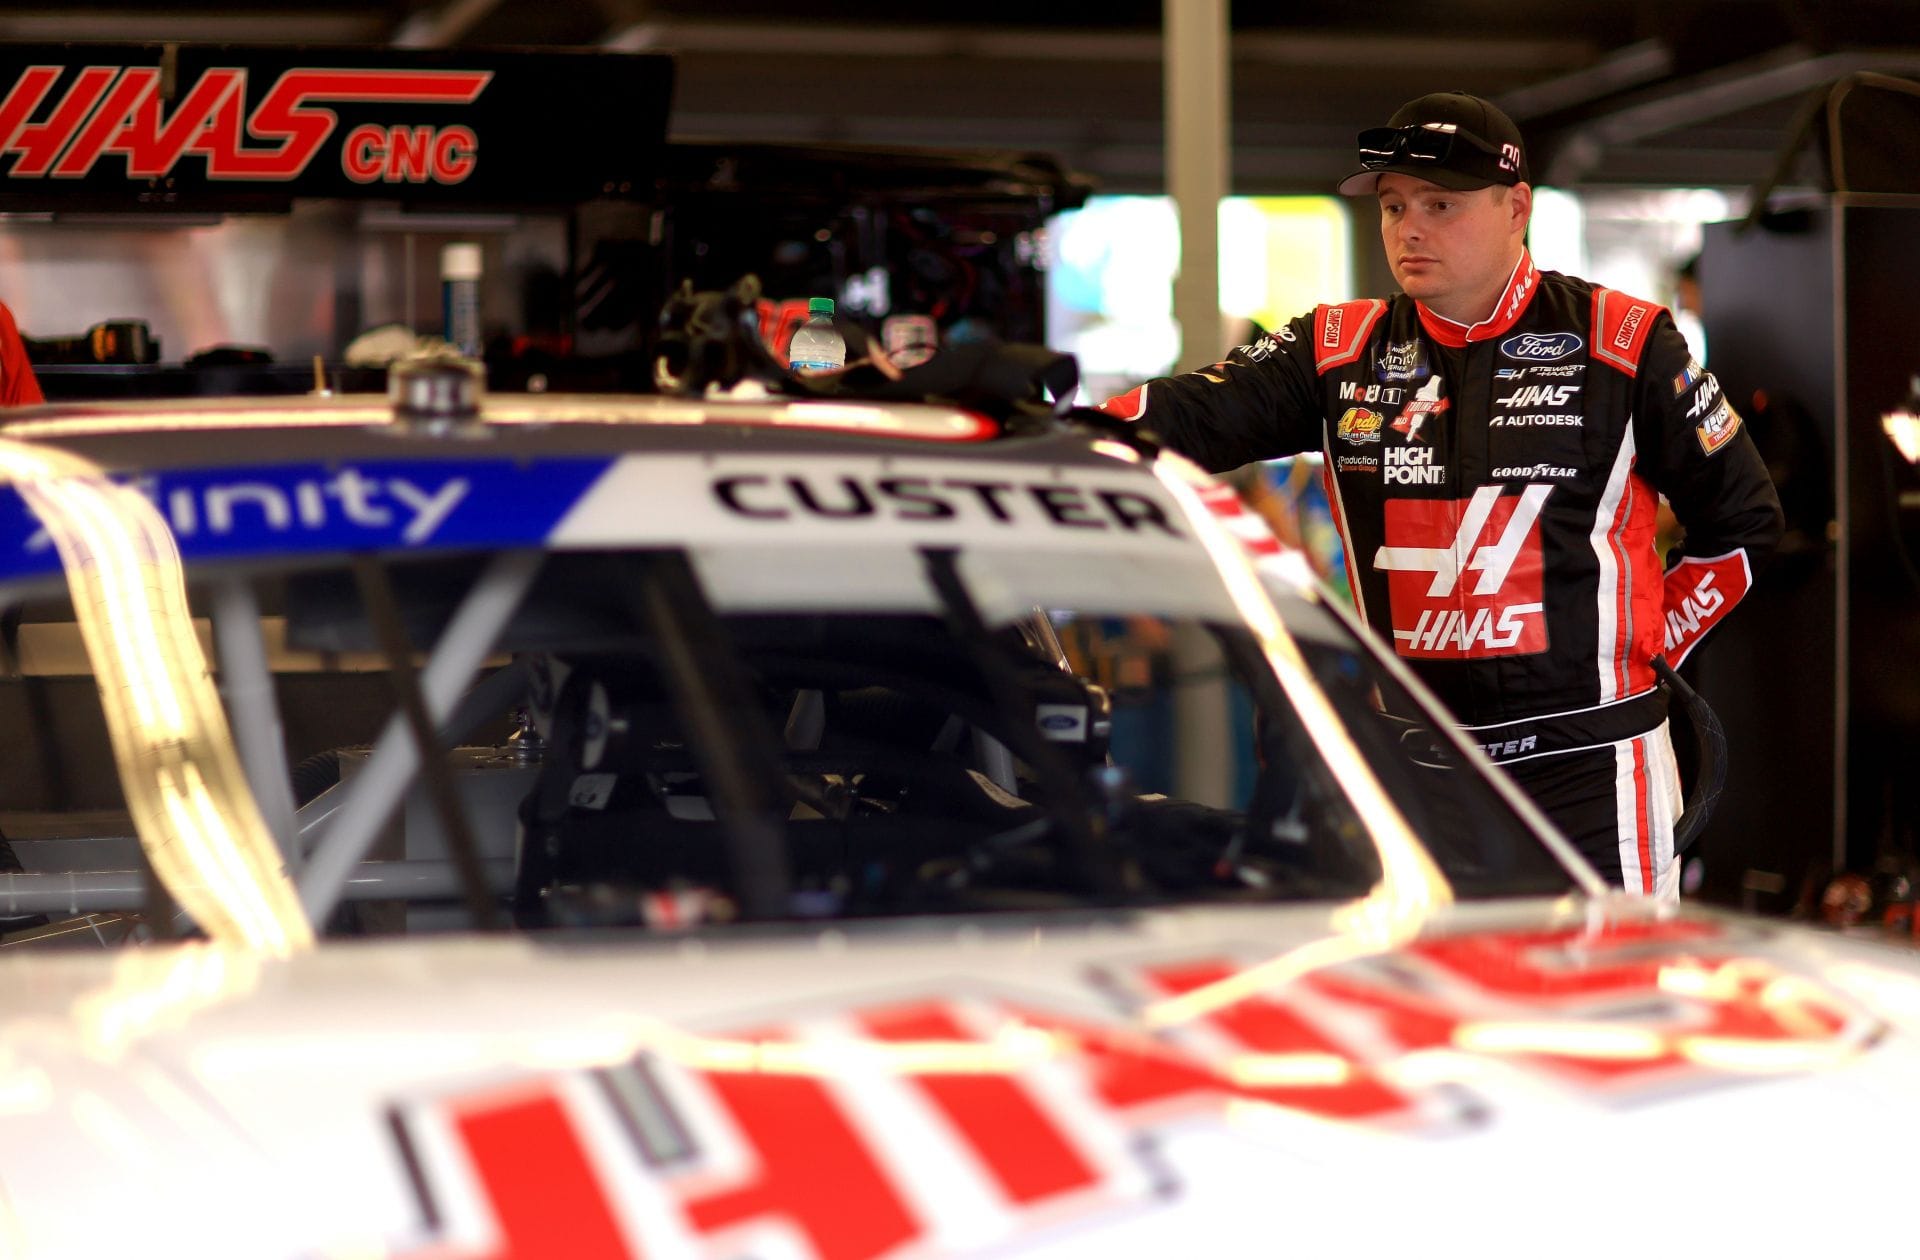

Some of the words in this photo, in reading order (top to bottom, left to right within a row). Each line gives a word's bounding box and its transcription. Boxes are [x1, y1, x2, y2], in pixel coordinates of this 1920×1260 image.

[0, 65, 495, 180] HAAS
[342, 124, 479, 184] CNC
[1325, 309, 1341, 344] SIMPSON
[1616, 307, 1644, 347] SIMPSON
[1516, 336, 1566, 356] Ford
[1529, 364, 1587, 373] STEWART
[1495, 385, 1580, 408] HAAS
[1685, 373, 1720, 419] HAA
[1506, 414, 1584, 427] AUTODESK
[1340, 456, 1378, 465] Production
[1384, 447, 1433, 466] HIGH
[1384, 465, 1442, 485] POINT
[1491, 463, 1578, 479] GOODYEAR
[709, 475, 1187, 539] CUSTER
[1394, 602, 1543, 651] HAAS
